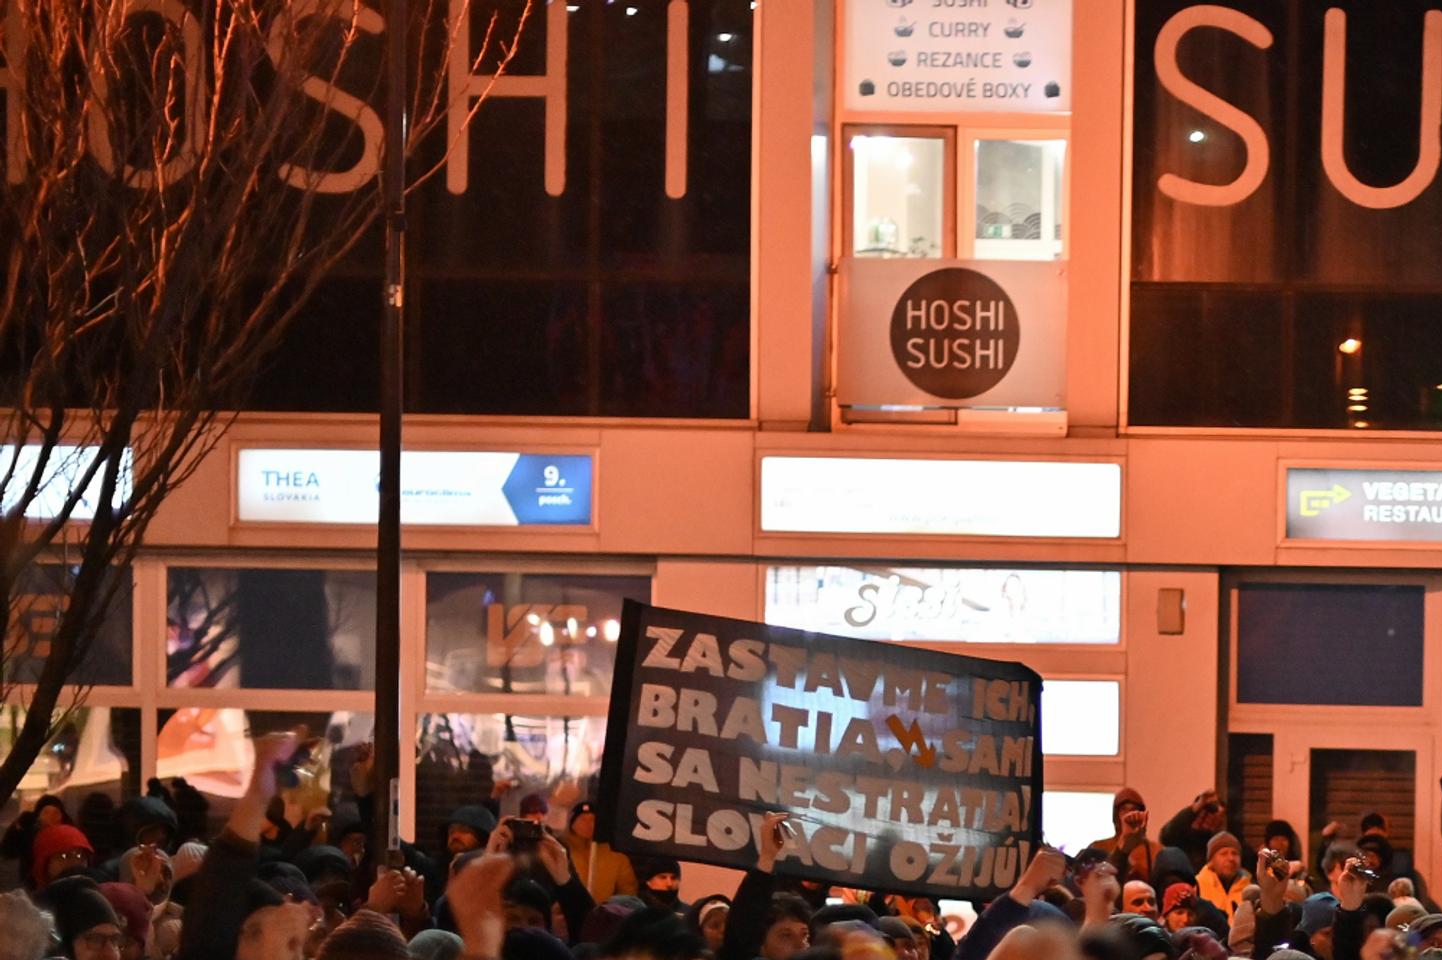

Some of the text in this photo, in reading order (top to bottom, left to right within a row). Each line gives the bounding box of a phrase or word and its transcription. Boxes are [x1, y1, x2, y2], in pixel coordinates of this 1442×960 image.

[928, 21, 992, 38] CURRY
[917, 52, 1003, 68] REZANCE
[887, 78, 1032, 98] OBEDOVÉ BOXY
[906, 299, 1005, 331] HOSHI
[906, 337, 1004, 370] SUSHI
[261, 470, 320, 488] THEA
[543, 465, 566, 487] 9.
[263, 492, 320, 502] SLOVAKIA
[642, 626, 1035, 728] ZASTAVME ICH,
[638, 683, 1033, 777] BRATIA, SAMI
[634, 741, 1031, 833] SA NESTRATIA!
[889, 831, 1031, 889] OŽIJÚ!
